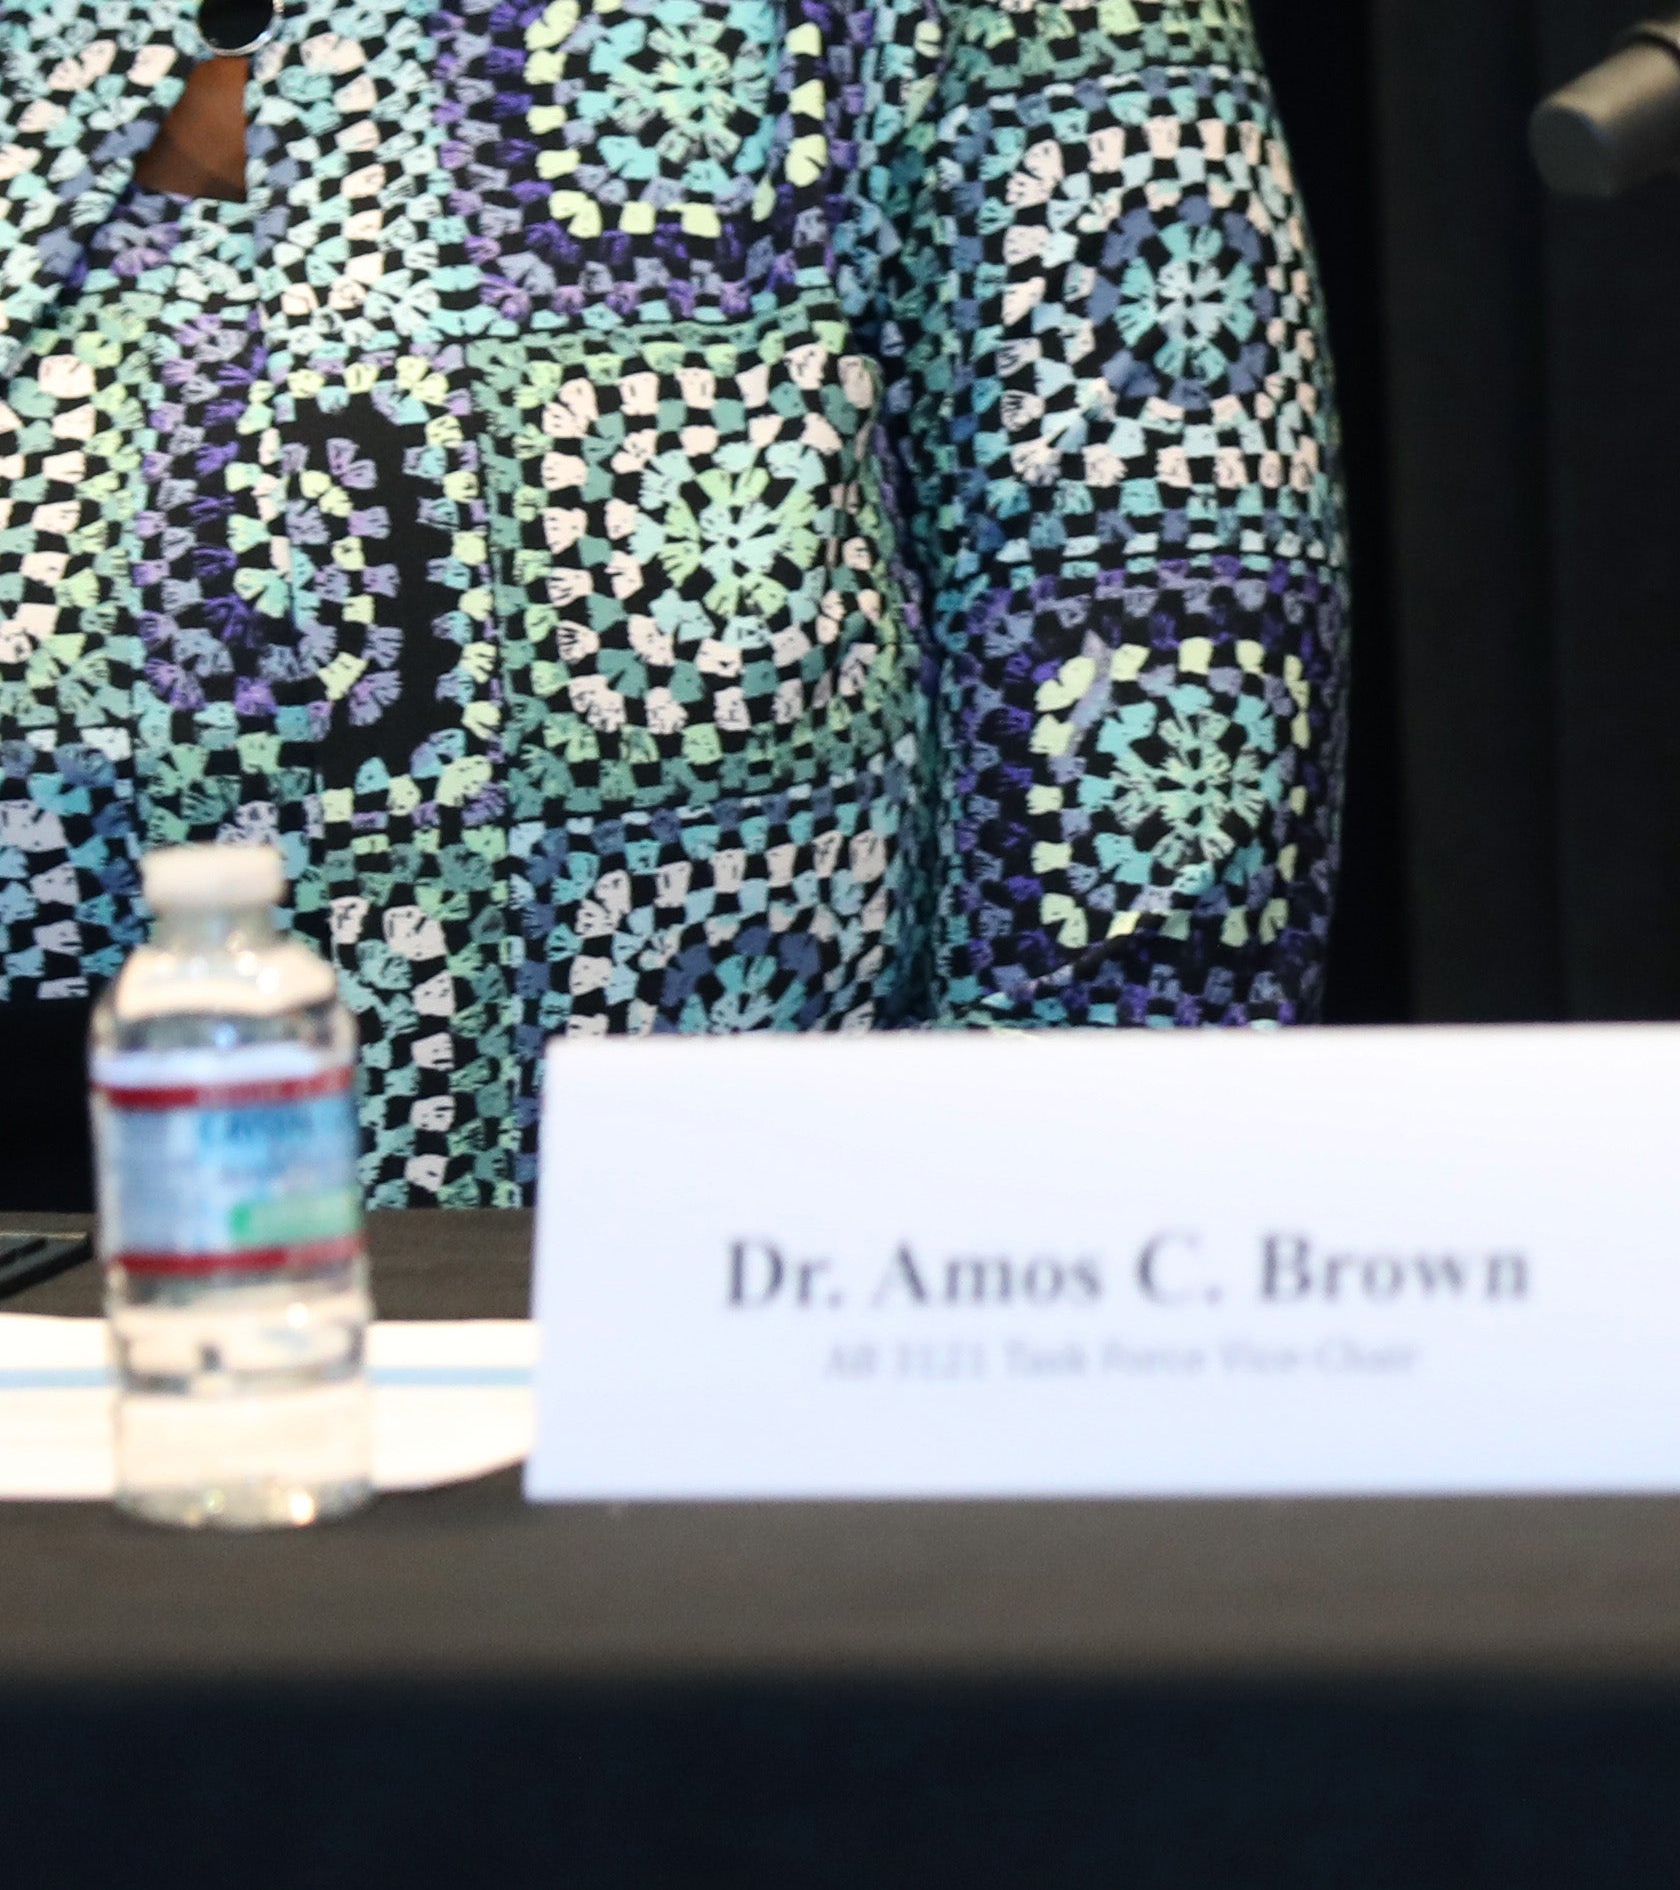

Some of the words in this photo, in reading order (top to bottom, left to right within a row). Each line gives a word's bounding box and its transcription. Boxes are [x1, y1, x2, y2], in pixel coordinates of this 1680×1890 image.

[728, 1239, 842, 1308] Dr.
[872, 1239, 1102, 1307] Amos
[1136, 1232, 1222, 1305] C.
[1258, 1231, 1530, 1303] Brown
[1003, 1339, 1088, 1378] Task
